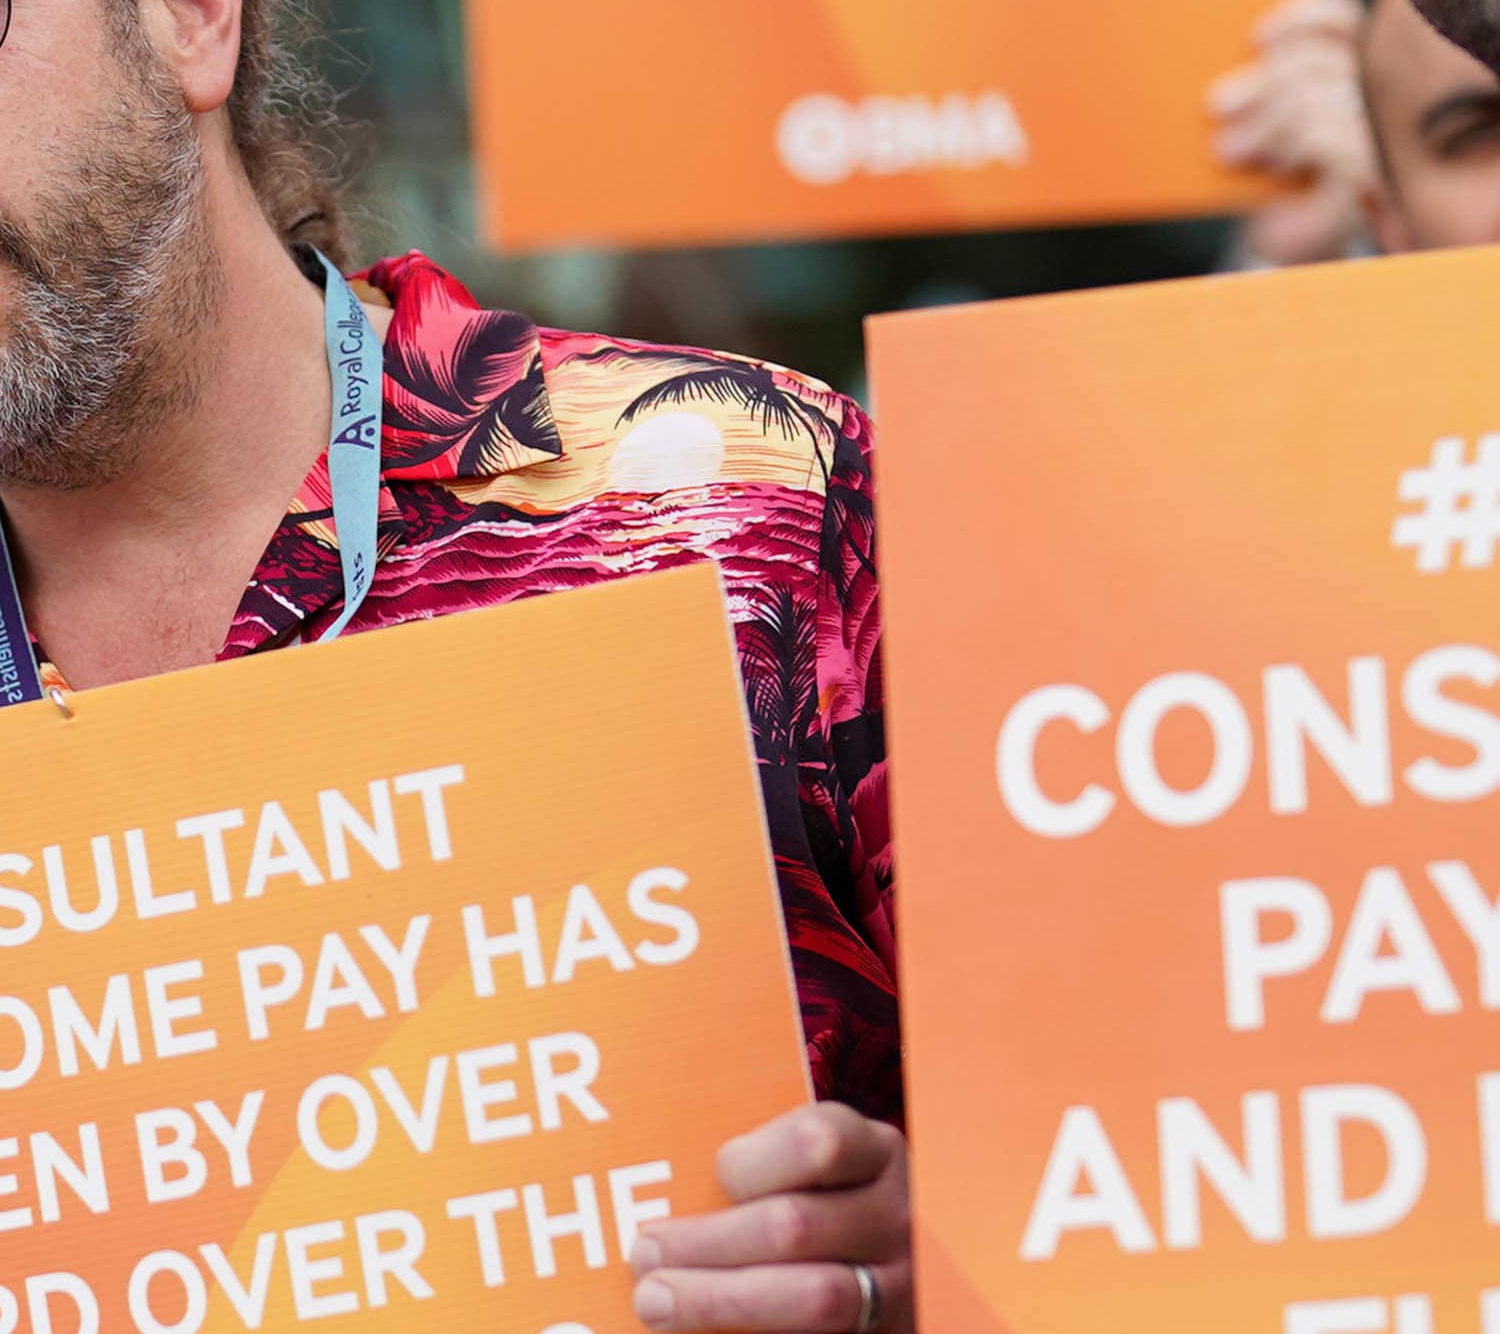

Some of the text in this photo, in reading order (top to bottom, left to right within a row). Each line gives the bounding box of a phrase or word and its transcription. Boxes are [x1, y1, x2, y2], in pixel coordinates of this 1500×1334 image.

[852, 92, 1026, 169] BMA
[338, 357, 369, 418] Royal
[236, 913, 432, 1041] PAY
[460, 865, 701, 999] HAS
[134, 1089, 266, 1204] BY
[295, 1030, 610, 1172] OVER
[1018, 1082, 1428, 1261] AND
[444, 1158, 674, 1287] THE
